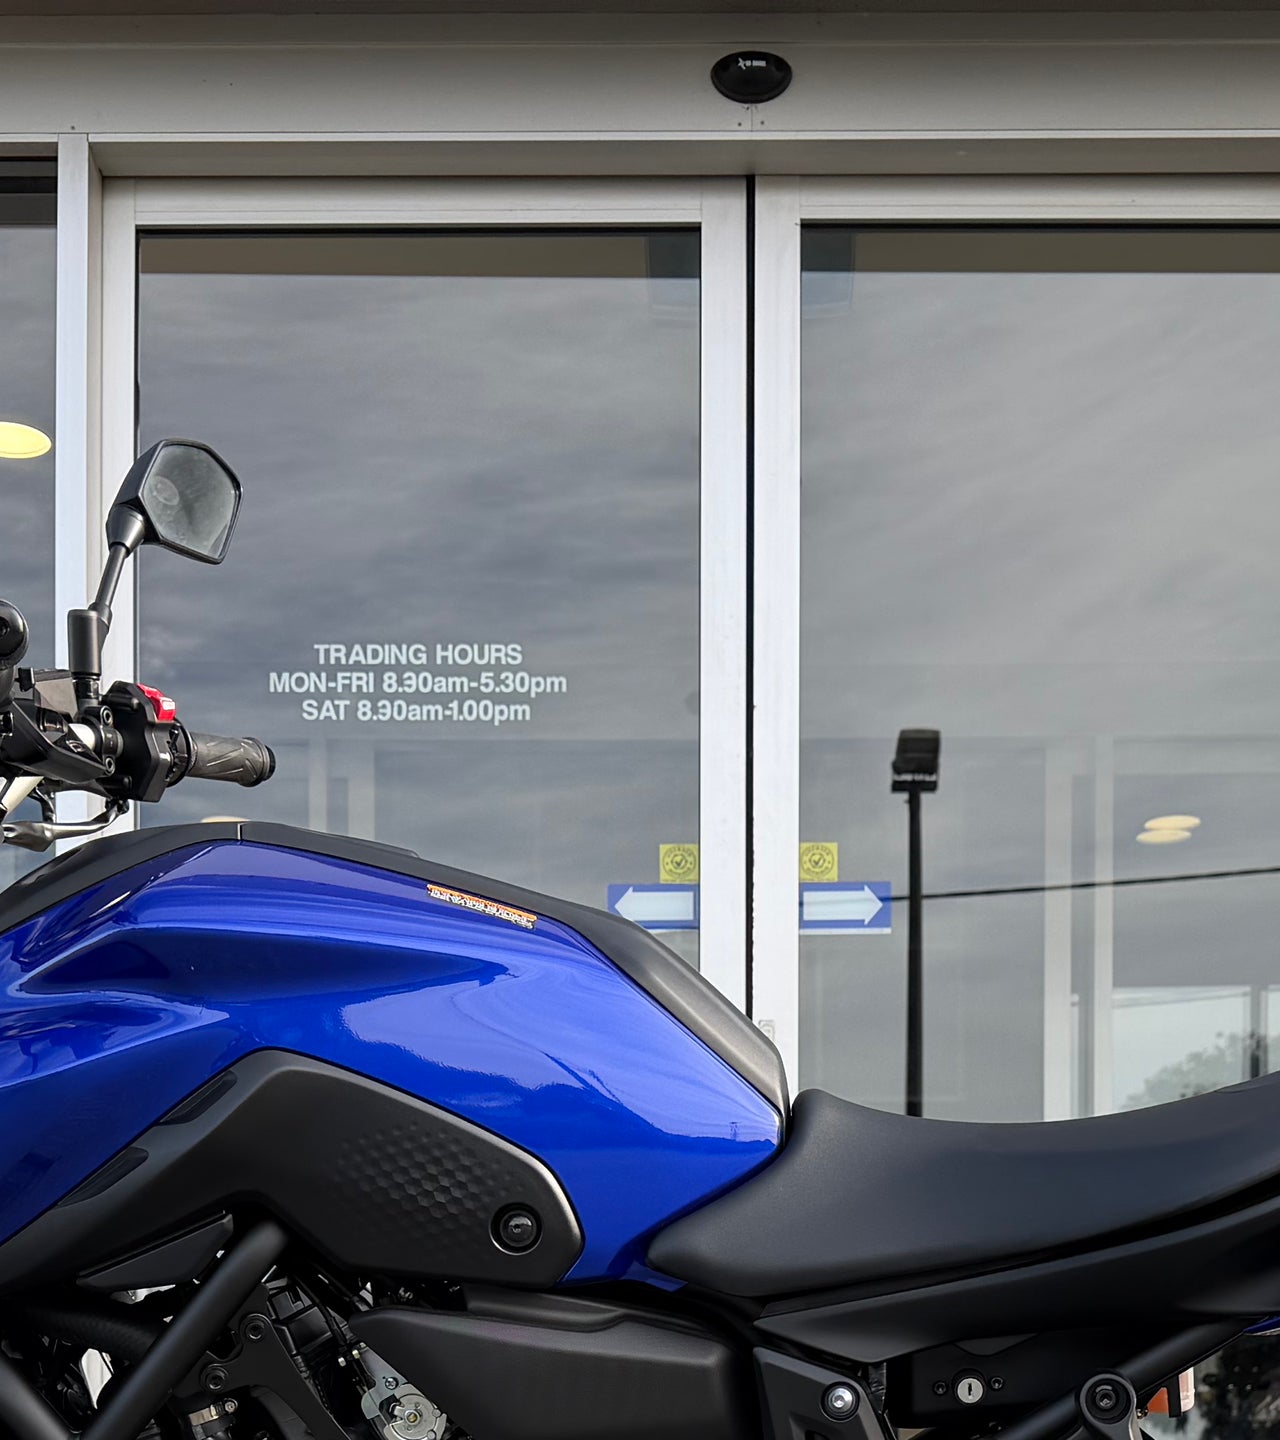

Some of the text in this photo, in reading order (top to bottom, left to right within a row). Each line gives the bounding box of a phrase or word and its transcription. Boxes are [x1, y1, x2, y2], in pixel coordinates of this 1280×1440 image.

[314, 643, 523, 666] TRADING HOURS
[269, 672, 375, 694] MON-FRI
[301, 700, 350, 721] SAT
